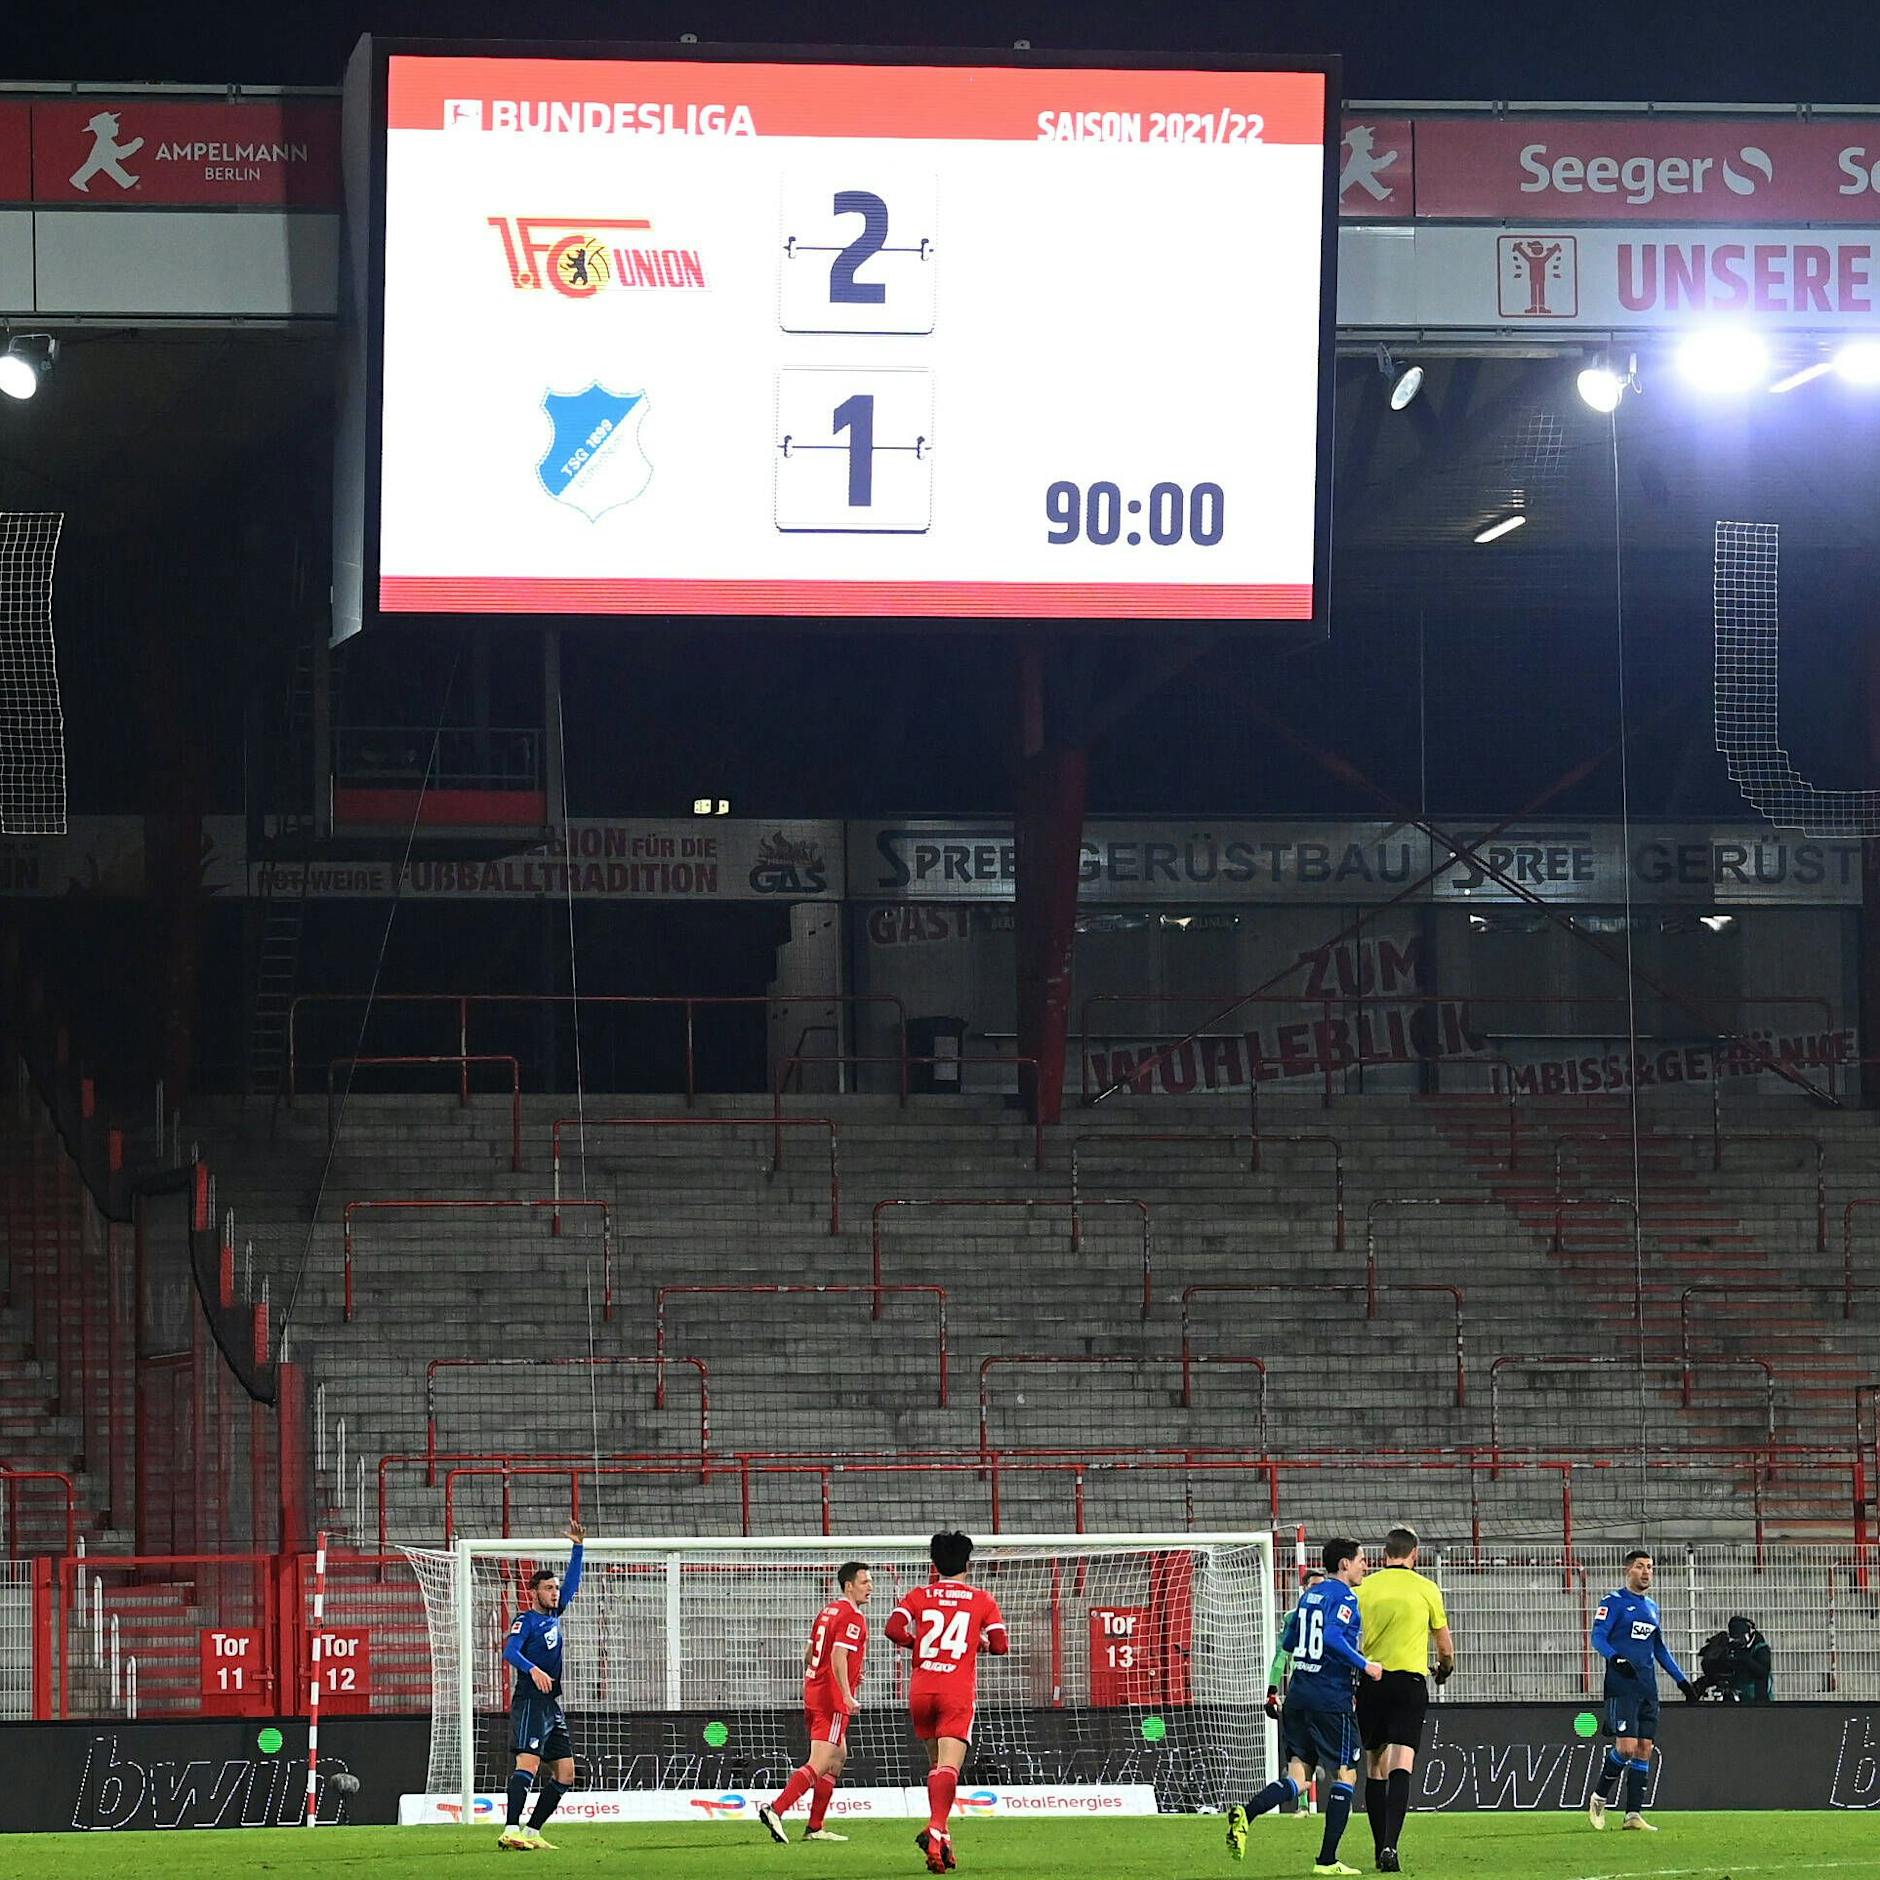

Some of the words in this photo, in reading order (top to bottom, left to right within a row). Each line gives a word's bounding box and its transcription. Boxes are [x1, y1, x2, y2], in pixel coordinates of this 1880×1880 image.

[493, 99, 757, 137] BUNDESLIGA
[1037, 111, 1142, 143] SAISON
[1149, 108, 1265, 144] 2021/22
[155, 141, 309, 162] AMPELMANN
[204, 167, 261, 182] BERLIN
[1519, 144, 1713, 204] Seeger
[829, 190, 889, 304] 2
[614, 248, 706, 288] UNION
[1617, 243, 1871, 313] UNSERE
[560, 447, 590, 477] TSG
[832, 394, 875, 507] 1
[1045, 480, 1225, 546] 90:00
[632, 832, 675, 858] FÜR
[681, 837, 718, 858] DIE
[877, 829, 1016, 888] SPREE
[1078, 832, 1410, 884] GERÜSTBAU
[1451, 831, 1597, 888] SPREE
[1634, 835, 1862, 885] GERÜST
[1299, 936, 1425, 1000] ZUM
[919, 1608, 971, 1660] 24
[1099, 1611, 1137, 1635] Tor
[1292, 1607, 1324, 1660] 16
[1633, 1624, 1651, 1637] SAP
[211, 1633, 250, 1657] Tor
[321, 1633, 360, 1657] Tor
[811, 1624, 827, 1668] 3
[1105, 1645, 1134, 1668] 13
[216, 1666, 244, 1690] 11
[326, 1666, 356, 1691] 12
[72, 1728, 350, 1829] bwin
[1002, 1794, 1122, 1811] TotalEnergies
